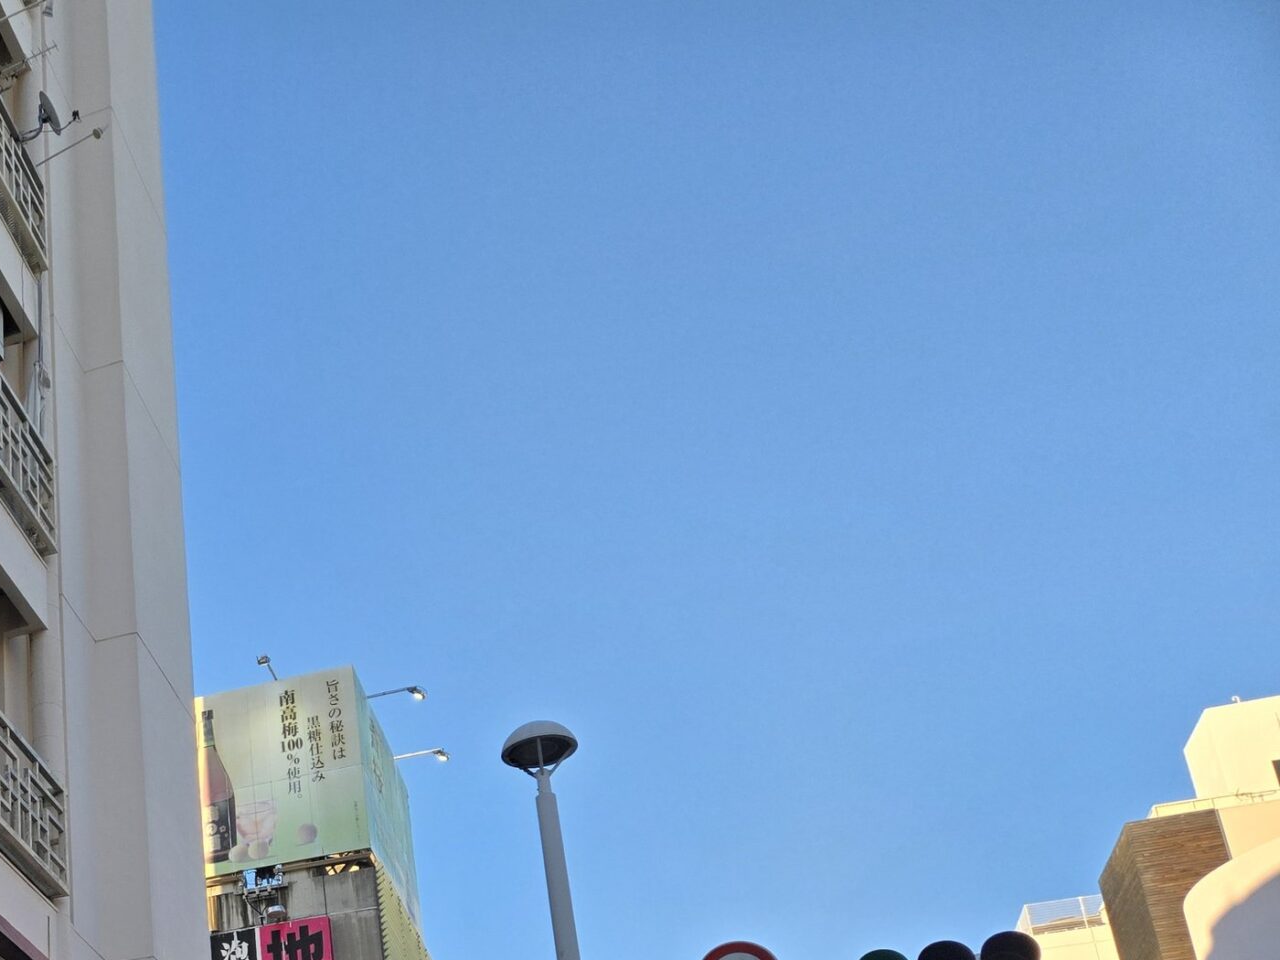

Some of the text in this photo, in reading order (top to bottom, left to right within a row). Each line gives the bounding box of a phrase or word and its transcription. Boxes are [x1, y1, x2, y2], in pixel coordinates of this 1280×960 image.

[307, 716, 325, 783] 黒糖仕込み
[325, 679, 347, 760] 旨さの秘訣は
